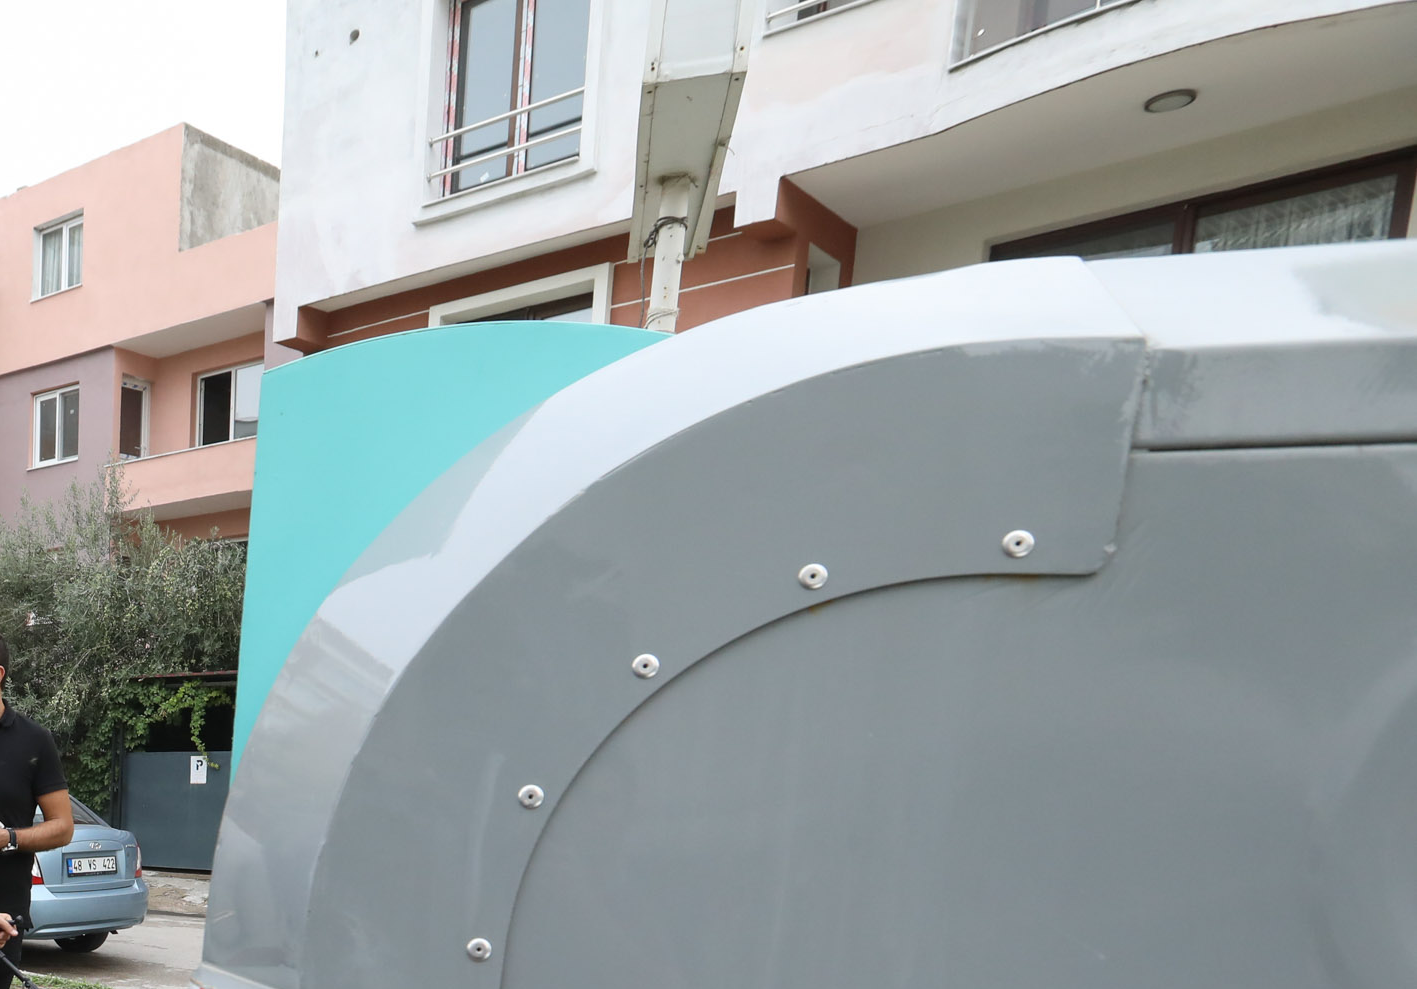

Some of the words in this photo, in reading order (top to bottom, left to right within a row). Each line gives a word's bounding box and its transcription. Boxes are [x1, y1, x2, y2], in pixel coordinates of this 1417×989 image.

[74, 860, 83, 872] 48
[88, 859, 97, 870] VS
[103, 858, 115, 870] 422
